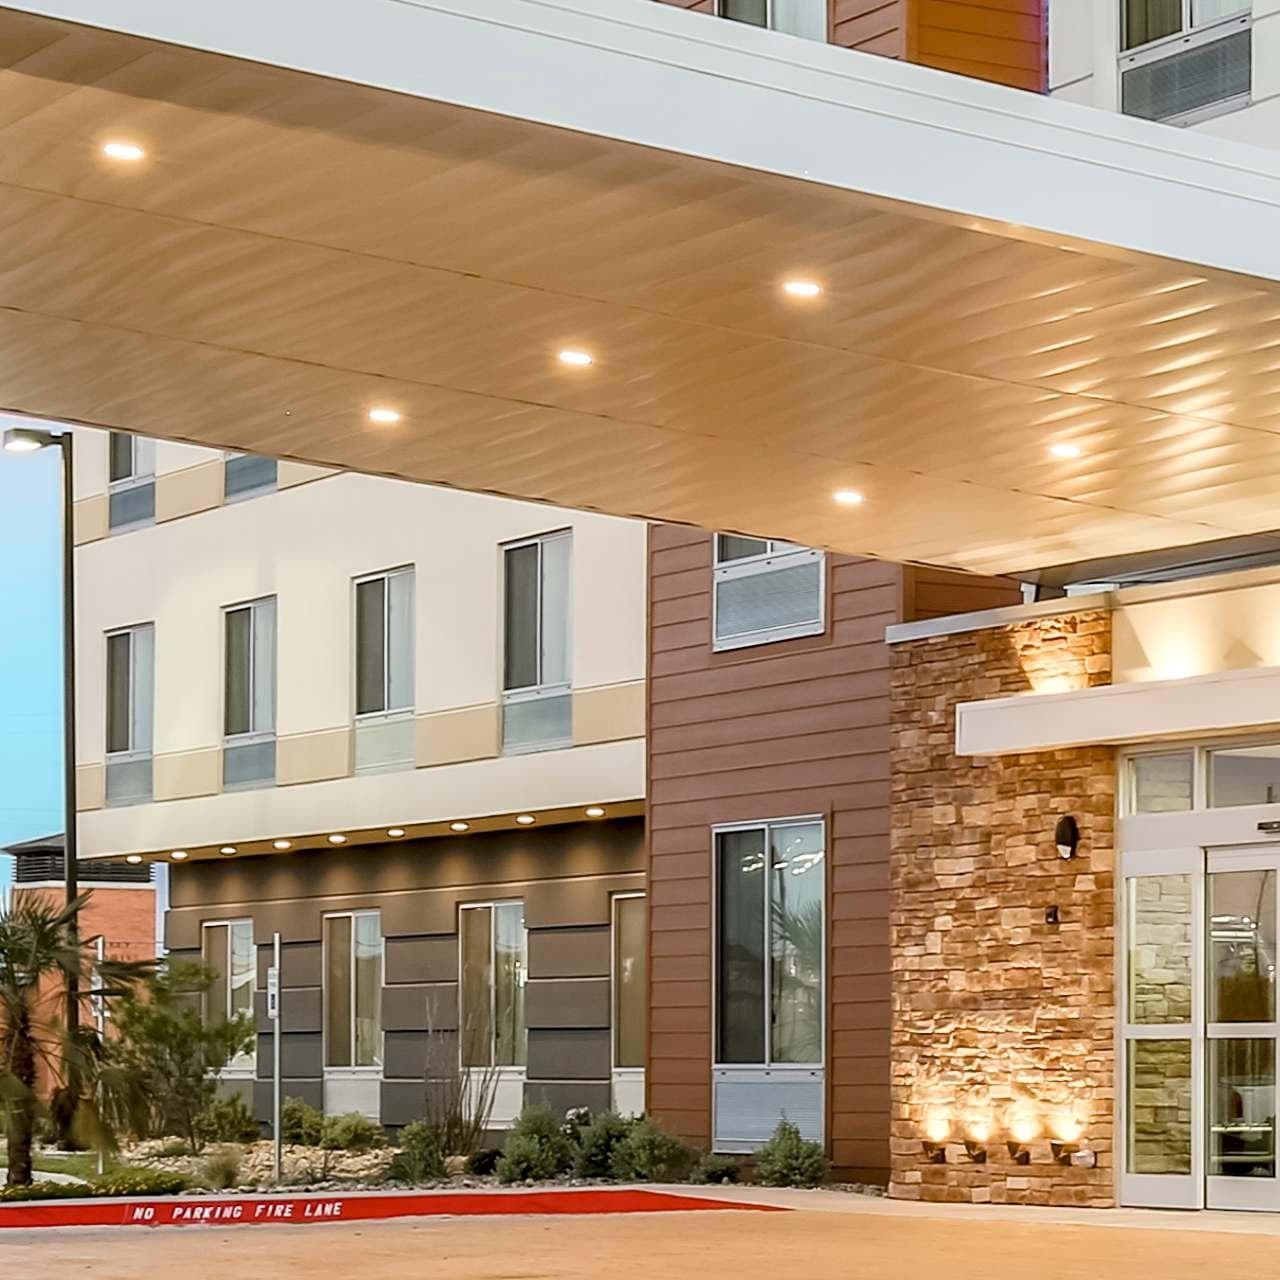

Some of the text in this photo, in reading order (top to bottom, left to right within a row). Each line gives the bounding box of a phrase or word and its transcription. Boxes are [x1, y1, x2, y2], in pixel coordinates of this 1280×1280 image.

[133, 1202, 342, 1220] NO PARKING FIRE LANE
